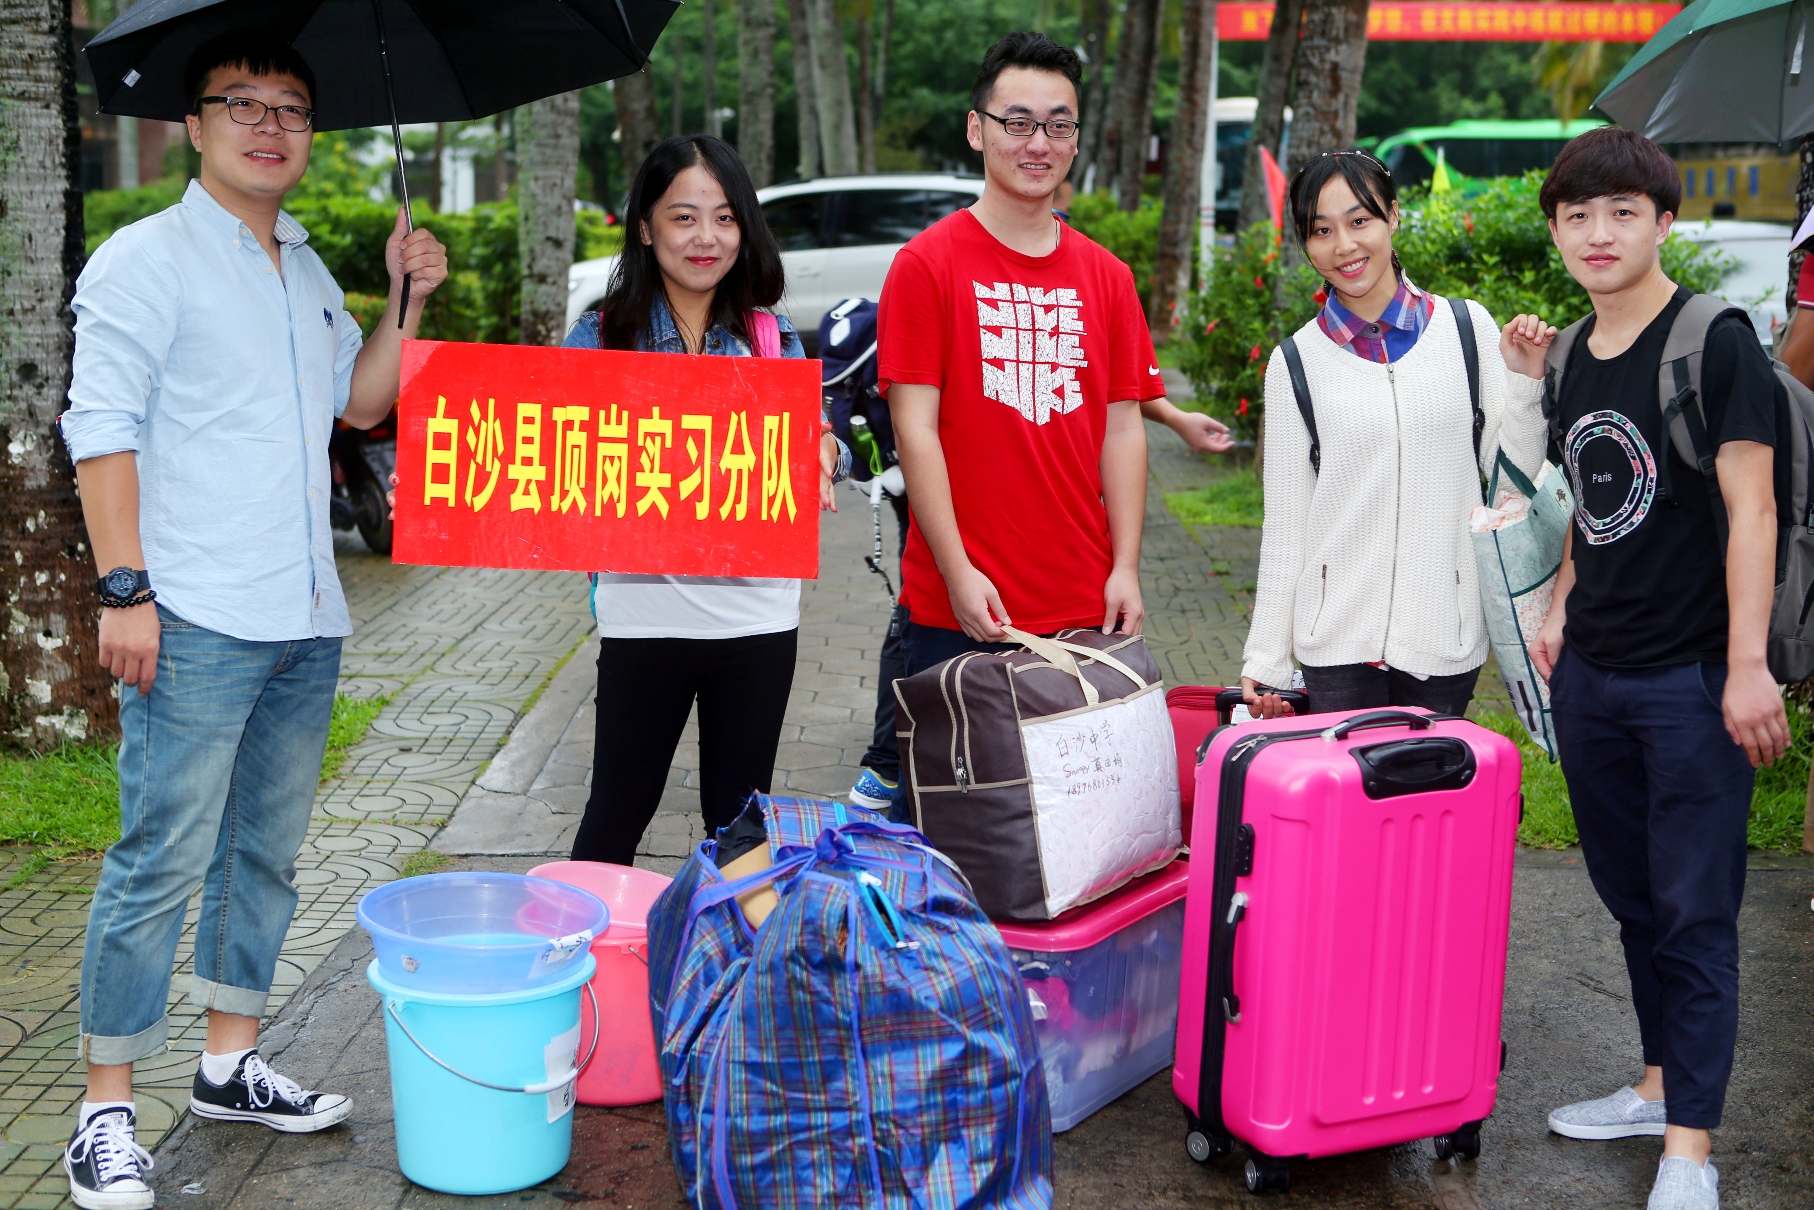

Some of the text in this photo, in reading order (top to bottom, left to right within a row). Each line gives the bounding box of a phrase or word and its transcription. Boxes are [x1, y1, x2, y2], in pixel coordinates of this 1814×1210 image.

[982, 361, 1083, 426] NIKE
[423, 394, 798, 525] 白沙县顶岗实习分队
[1592, 472, 1612, 483] Paris
